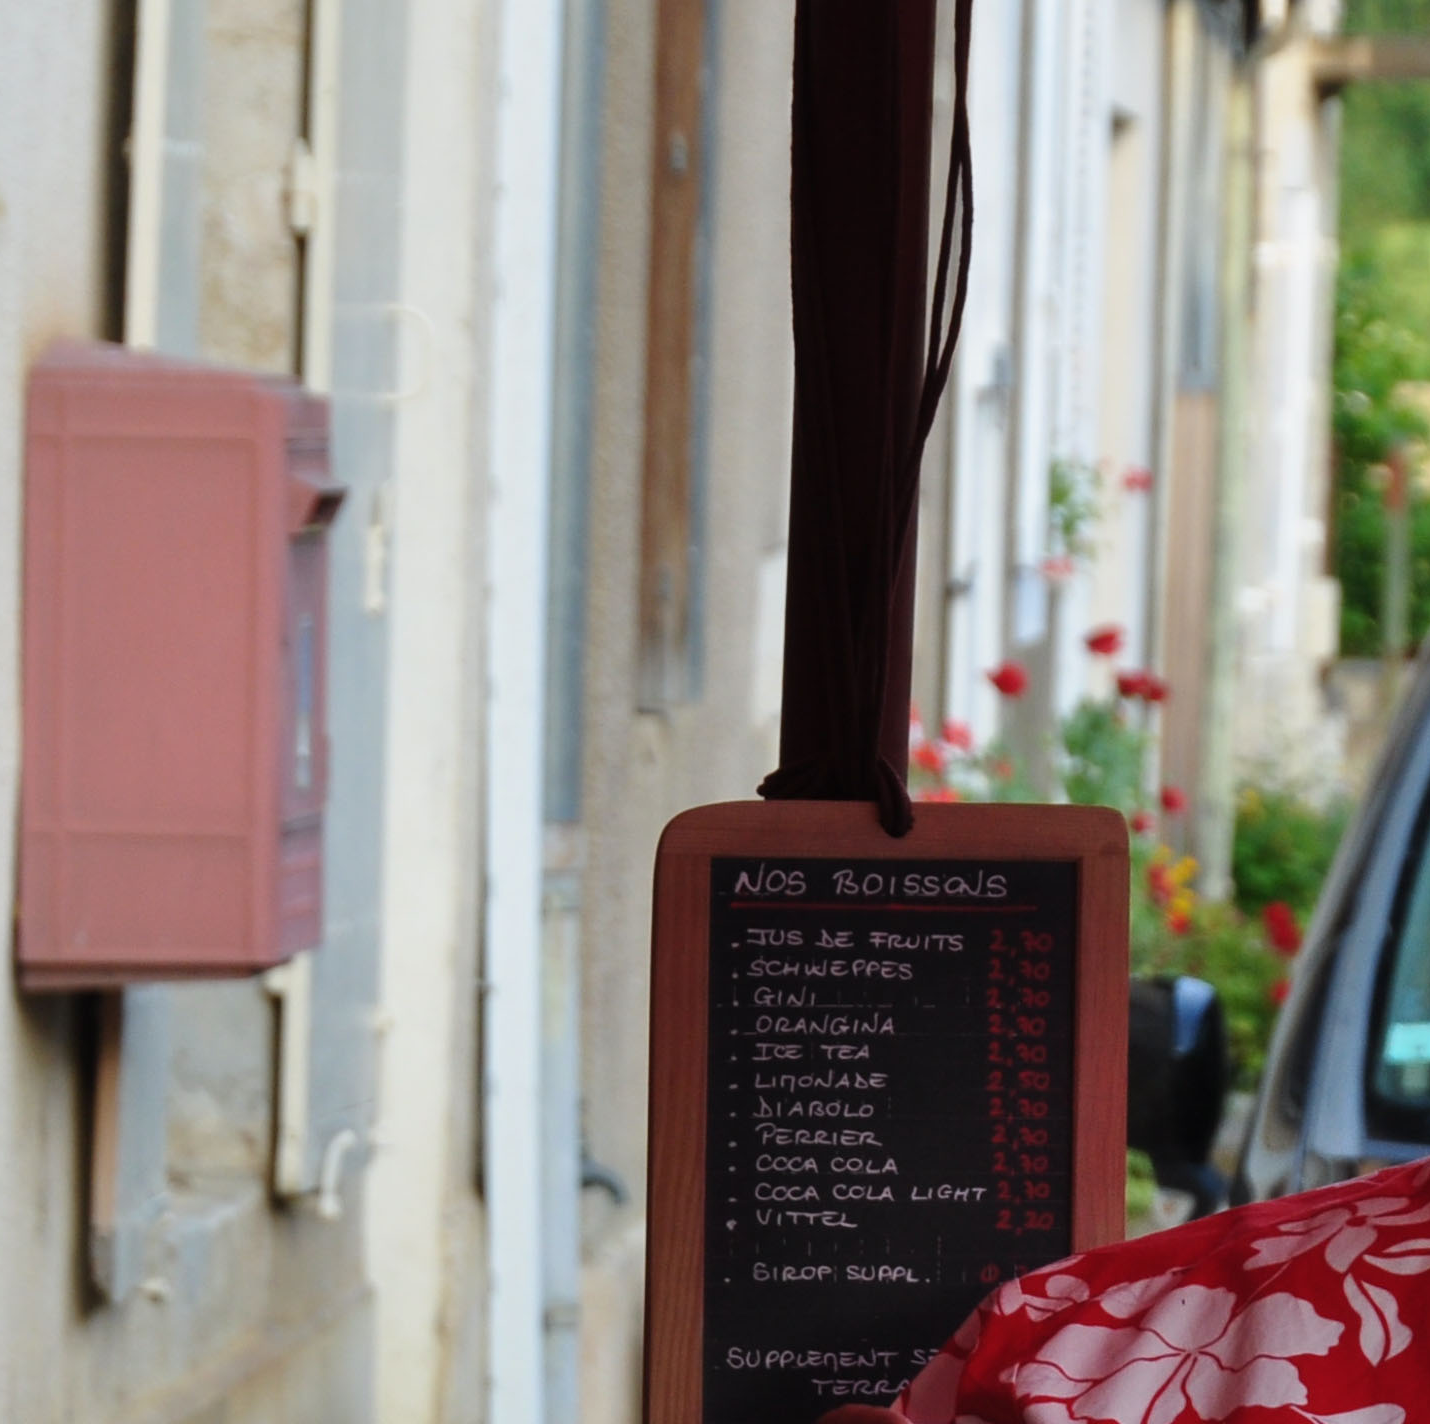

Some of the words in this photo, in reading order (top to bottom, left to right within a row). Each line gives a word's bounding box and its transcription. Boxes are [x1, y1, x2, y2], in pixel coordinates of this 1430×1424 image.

[734, 863, 807, 896] NOS
[832, 869, 1008, 898] BOISSONS
[746, 927, 804, 948] JUS
[815, 928, 855, 949] DE
[868, 930, 965, 952] FRUITS
[746, 957, 914, 981] SCHWEPPES
[753, 985, 817, 1007] GINI
[755, 1012, 896, 1035] ORANGINA
[751, 1042, 804, 1062] ICE
[819, 1043, 871, 1061] TEA
[754, 1070, 889, 1093] LIMONADE
[752, 1096, 875, 1119] DIABOLO
[754, 1122, 883, 1148] PERRIER
[755, 1153, 819, 1173] COCA
[830, 1155, 899, 1175] COLA
[754, 1182, 820, 1201] COCA
[831, 1182, 896, 1201] COLA
[911, 1184, 988, 1201] LIGHT
[755, 1209, 859, 1228] VITTEL
[752, 1261, 834, 1282] SIROP
[846, 1264, 931, 1284] SUPPL.
[725, 1346, 899, 1372] SUPPLEMENT
